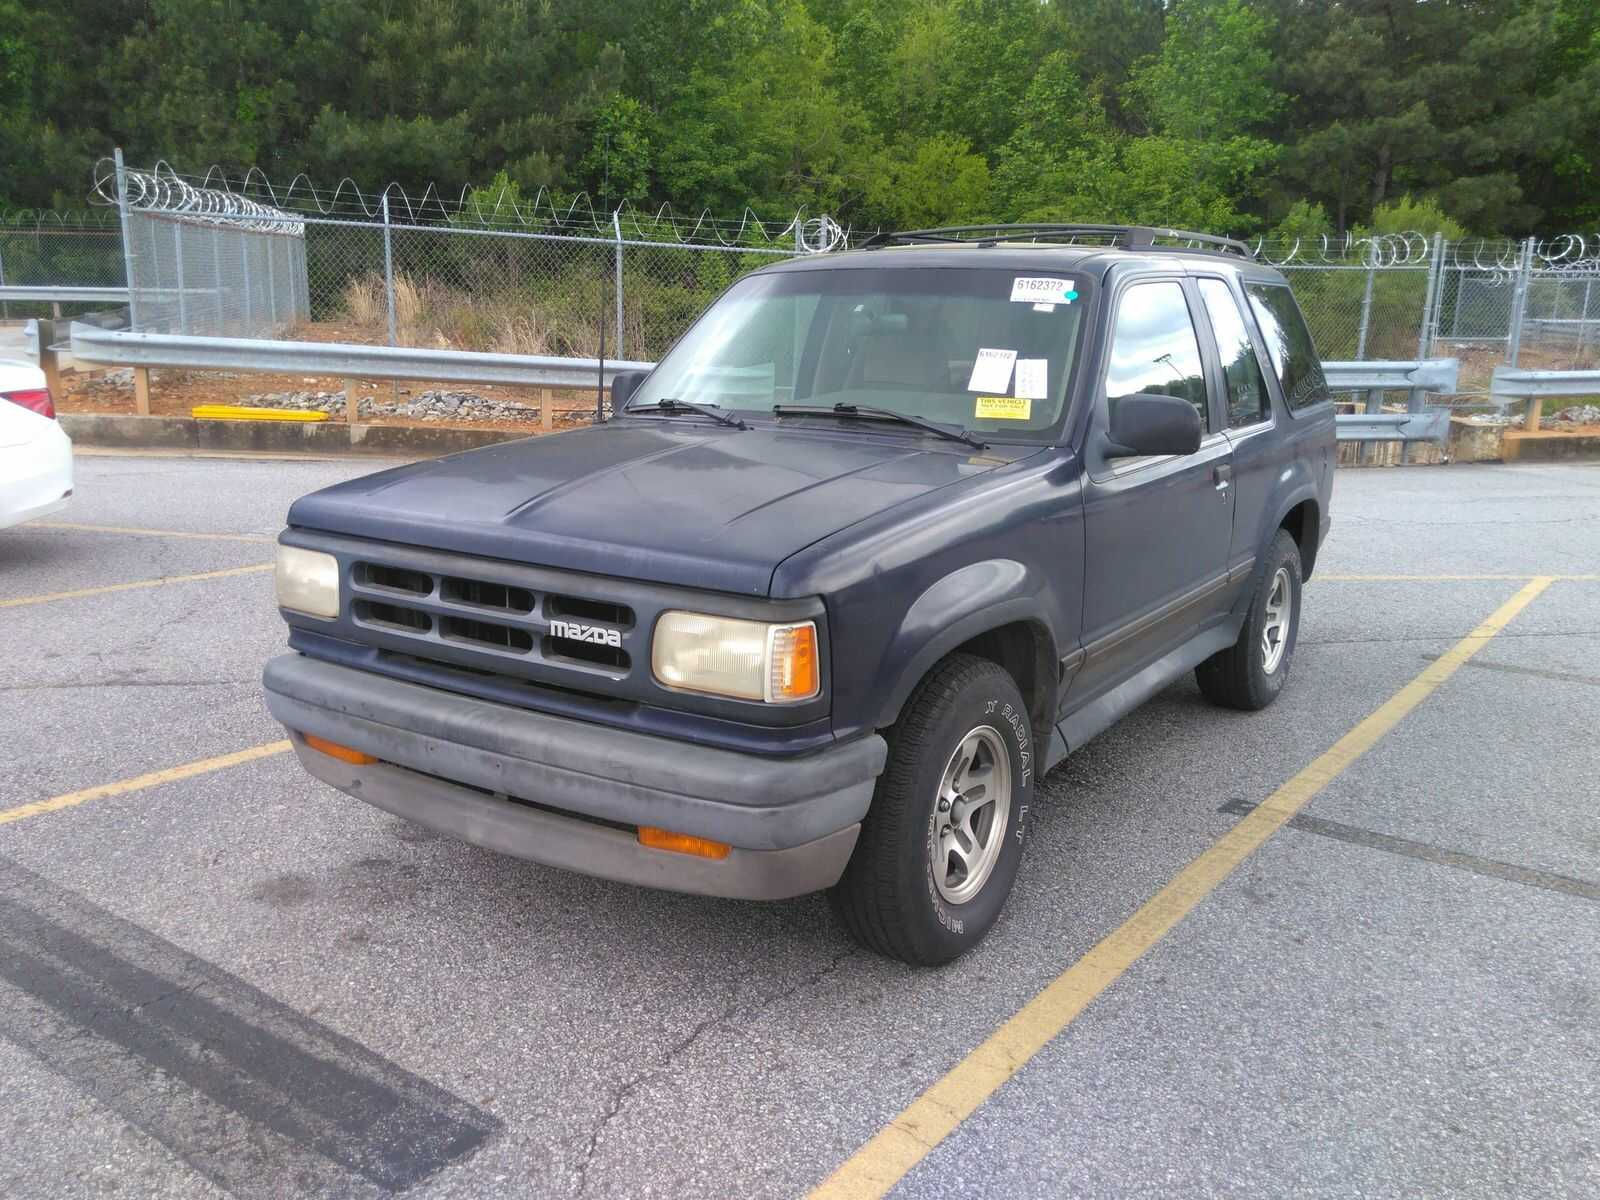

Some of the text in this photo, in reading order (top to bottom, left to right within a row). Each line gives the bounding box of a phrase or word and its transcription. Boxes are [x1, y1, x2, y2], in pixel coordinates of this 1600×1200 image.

[1017, 280, 1063, 291] 6162372
[1002, 703, 1031, 787] RADIAL
[1016, 805, 1029, 845] LT
